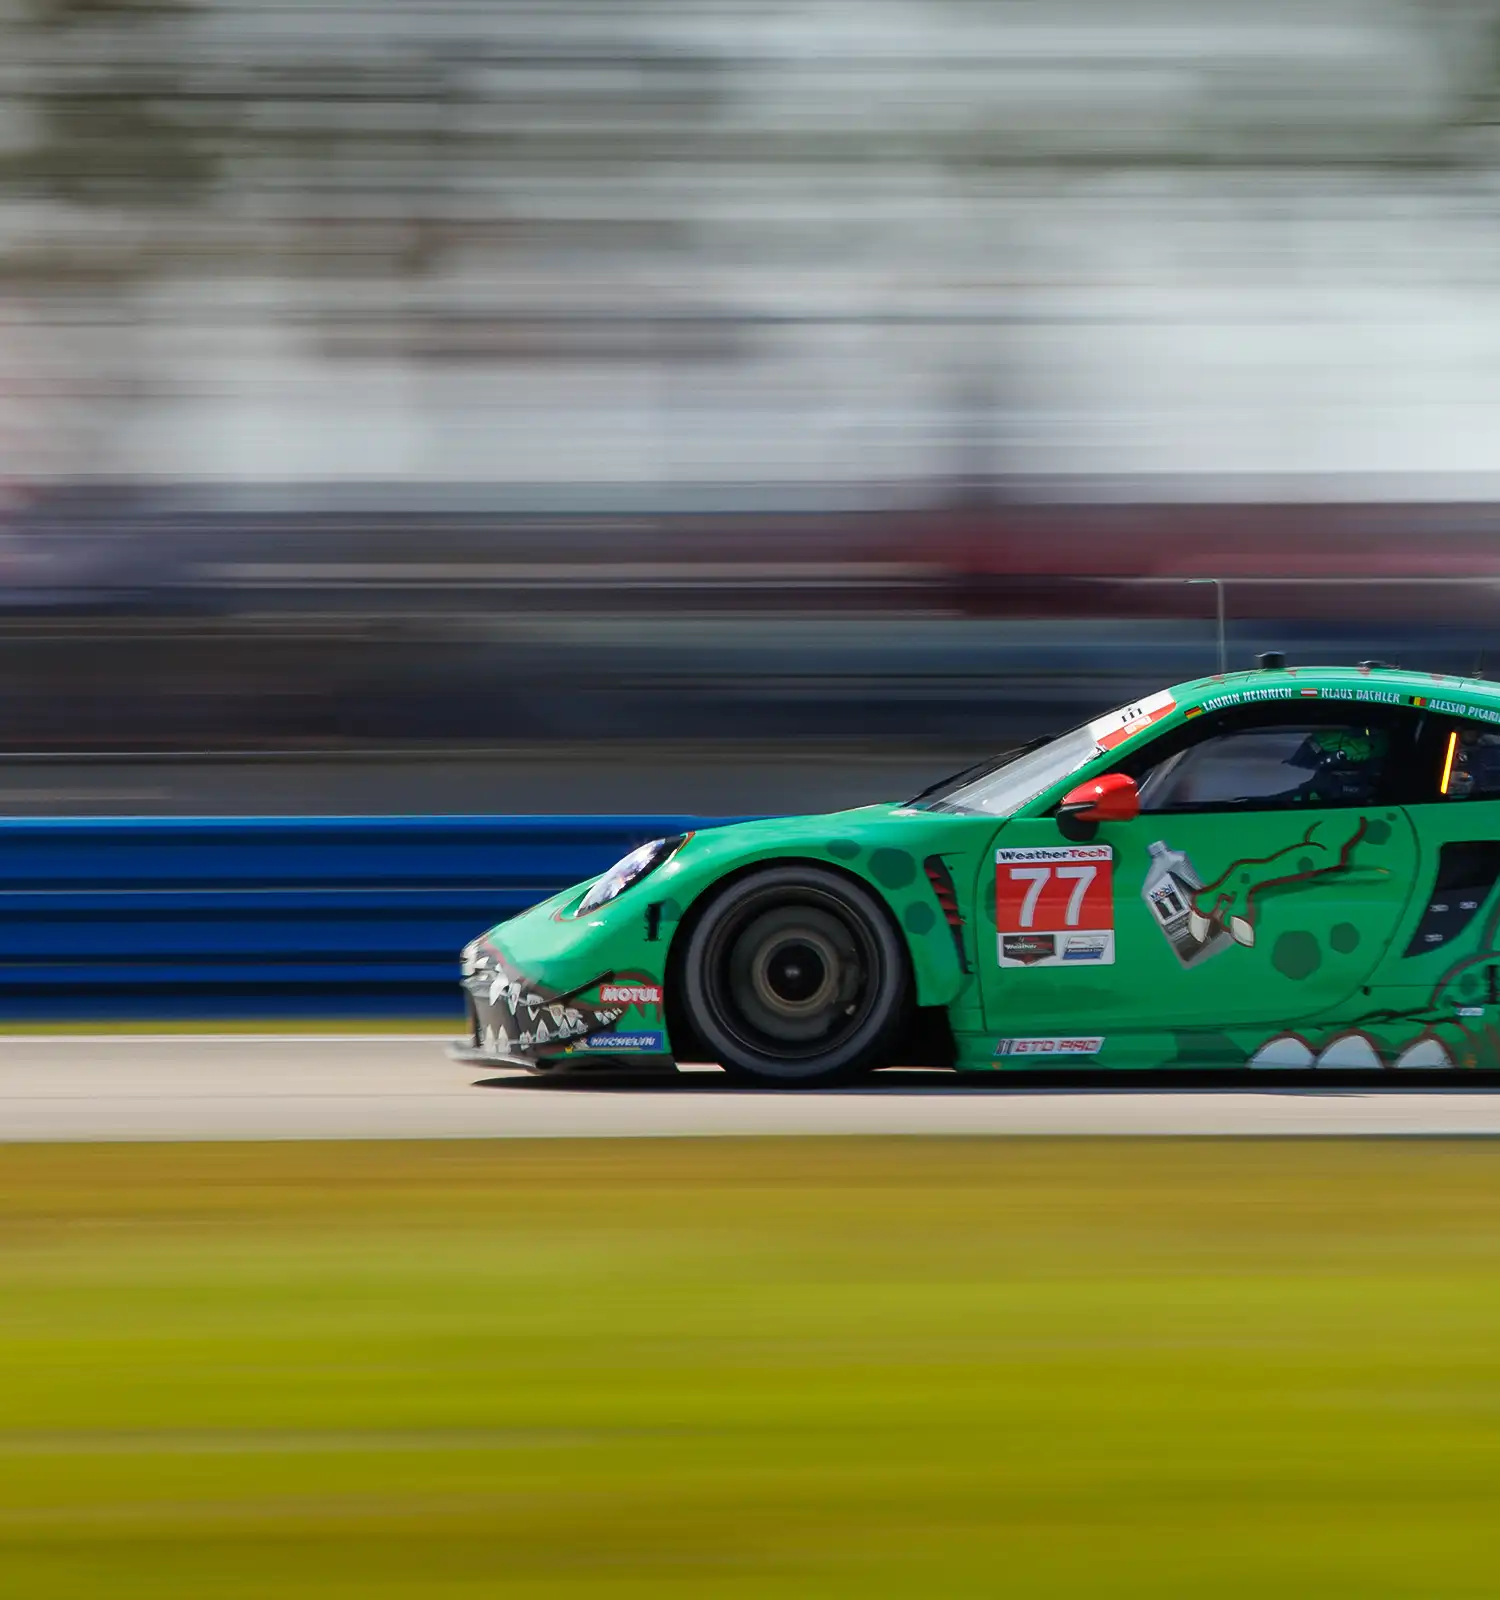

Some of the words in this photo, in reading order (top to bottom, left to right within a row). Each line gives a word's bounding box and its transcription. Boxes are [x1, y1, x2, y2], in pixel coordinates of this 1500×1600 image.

[1202, 692, 1241, 711] LAURIN
[1243, 687, 1293, 702] HEINRICH
[1321, 687, 1353, 700] KLAUS
[1356, 689, 1401, 704] BACHLER
[1428, 698, 1466, 714] ALESSIO
[1000, 848, 1108, 861] WeatherTech
[1009, 866, 1098, 928] 77
[1150, 882, 1176, 901] Mobil
[601, 986, 661, 1002] MOTUL
[590, 1035, 656, 1047] MICHELIN
